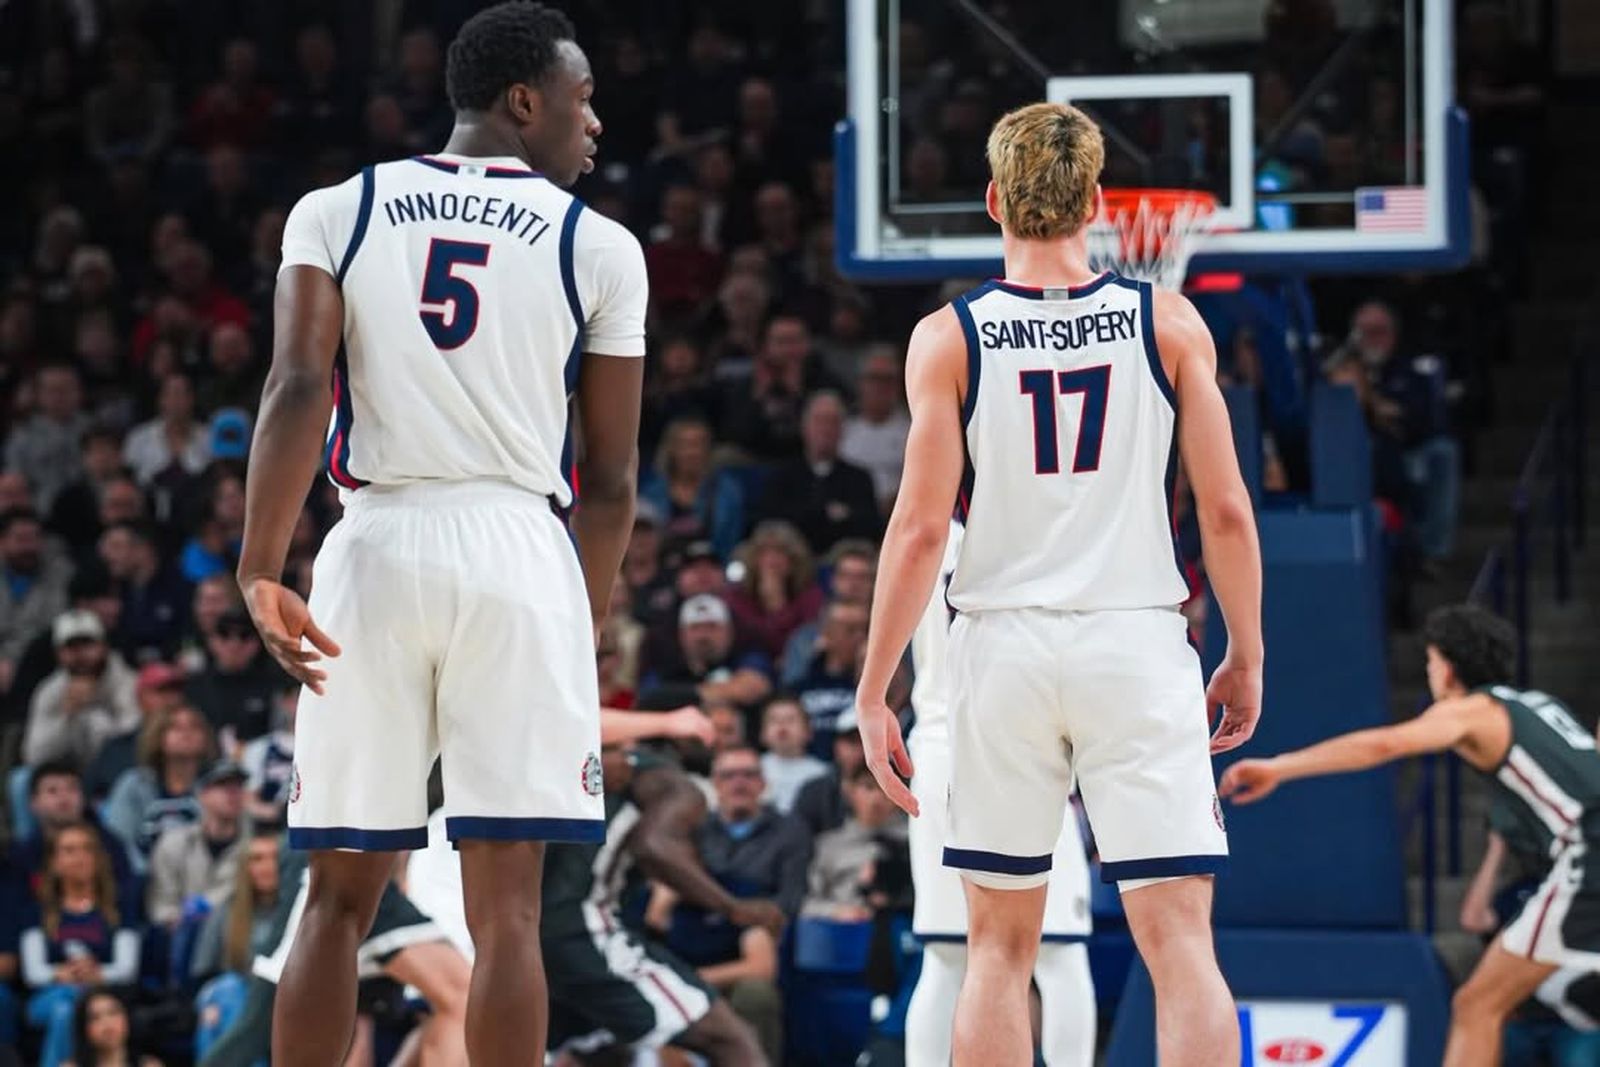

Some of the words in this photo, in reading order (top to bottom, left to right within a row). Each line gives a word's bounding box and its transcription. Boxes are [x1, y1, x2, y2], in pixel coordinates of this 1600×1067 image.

[384, 192, 550, 246] INNOCENTI
[419, 237, 491, 351] 5
[981, 304, 1137, 351] SAINT-SUPÉRY
[1019, 364, 1112, 475] 17
